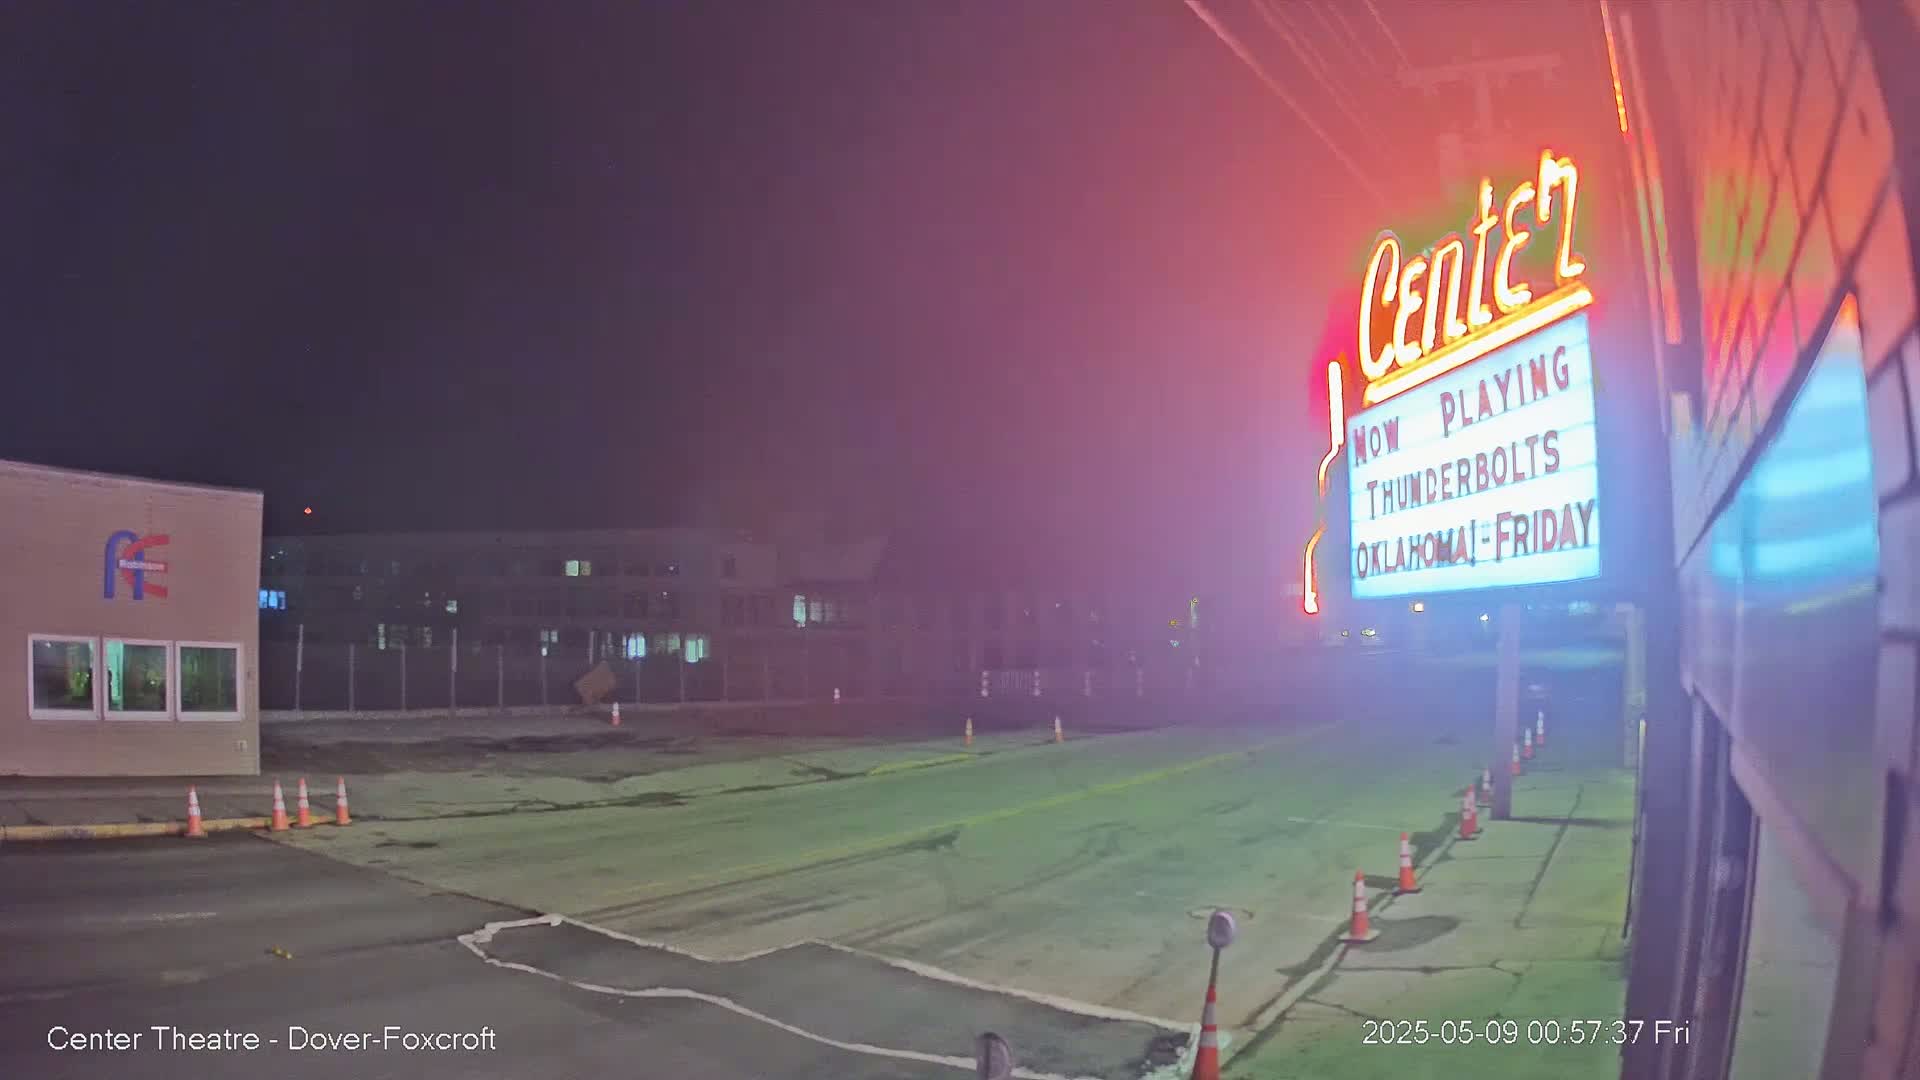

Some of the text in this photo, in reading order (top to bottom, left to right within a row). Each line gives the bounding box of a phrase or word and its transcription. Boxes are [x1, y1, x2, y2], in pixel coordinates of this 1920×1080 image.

[1353, 345, 1569, 467] NOW PLAYING
[1366, 430, 1561, 520] THUNDERBOLTS
